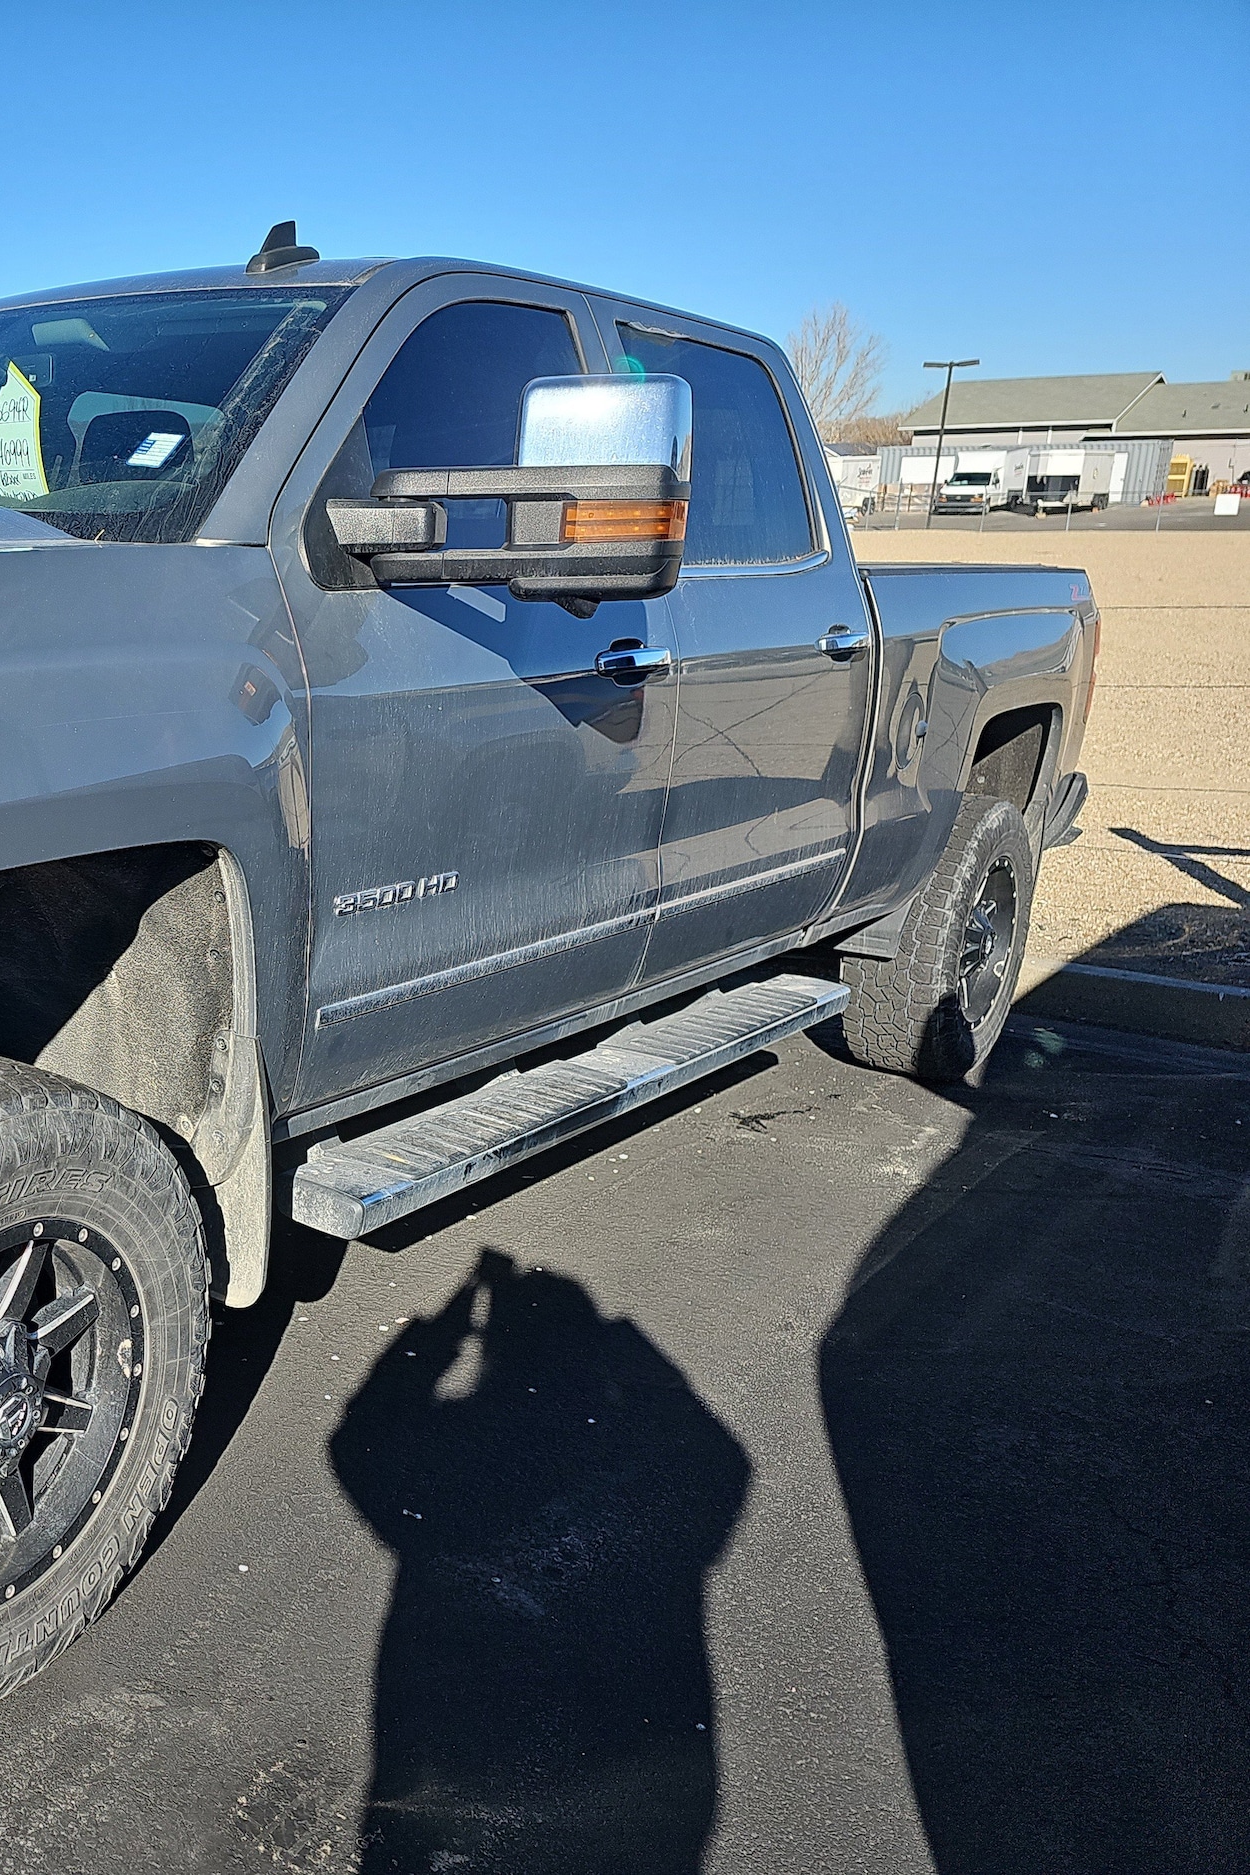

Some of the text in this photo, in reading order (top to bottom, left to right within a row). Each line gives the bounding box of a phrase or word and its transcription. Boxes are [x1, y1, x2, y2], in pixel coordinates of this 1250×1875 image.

[22, 472, 36, 480] MILES
[416, 870, 460, 899] HD
[121, 1397, 179, 1535] OPEN
